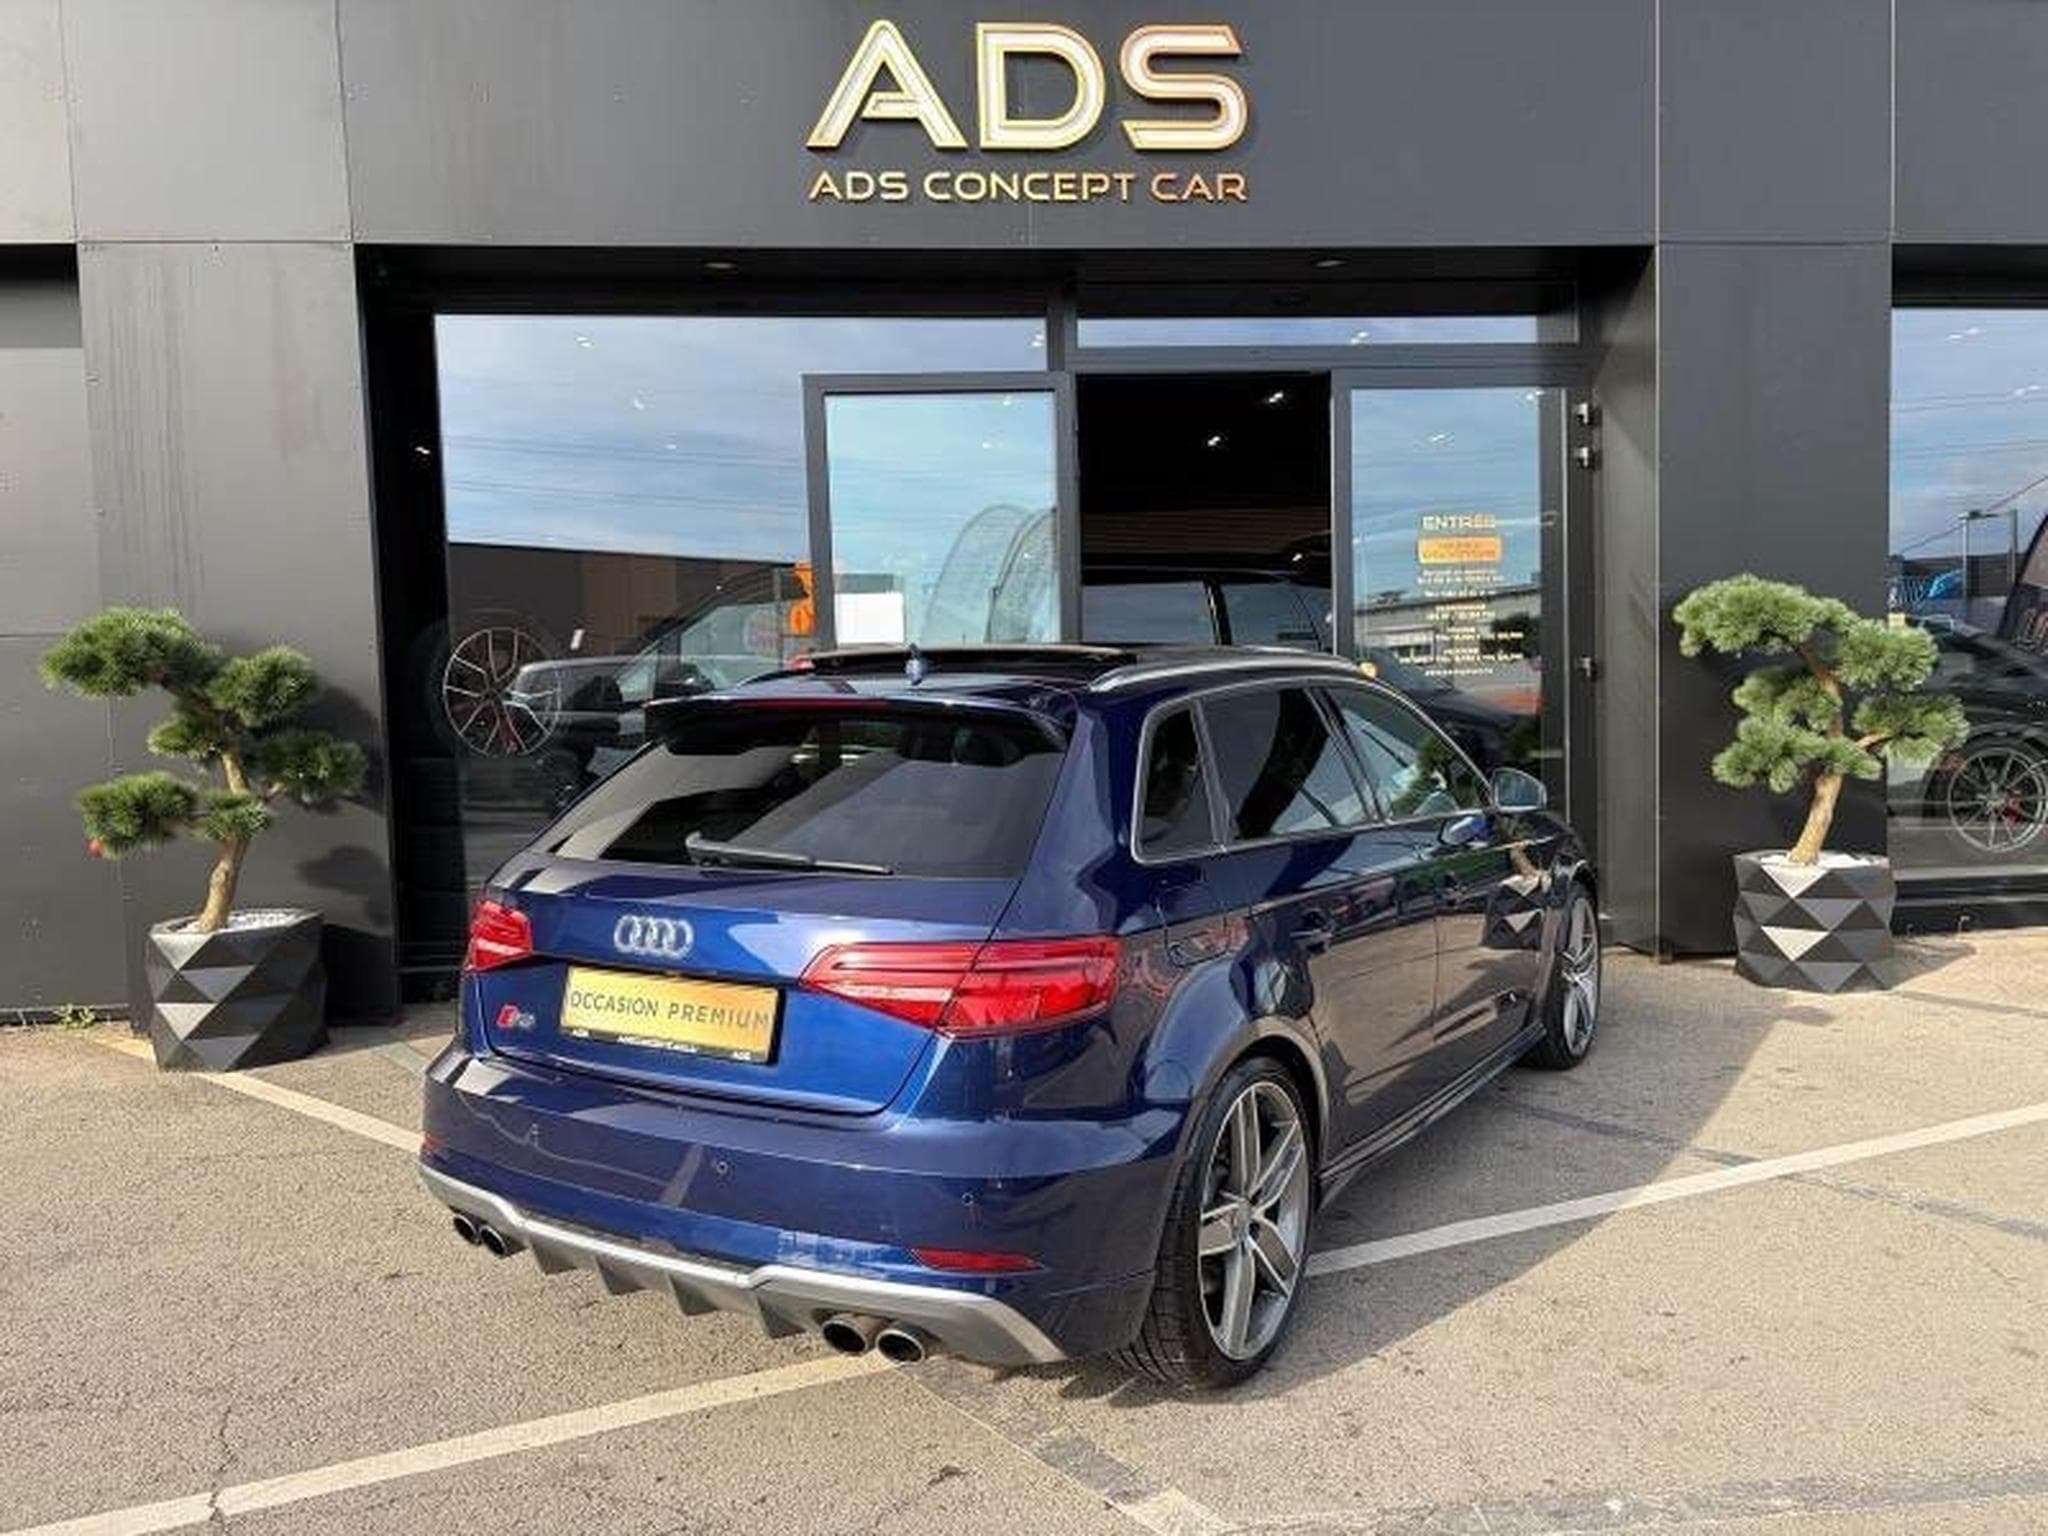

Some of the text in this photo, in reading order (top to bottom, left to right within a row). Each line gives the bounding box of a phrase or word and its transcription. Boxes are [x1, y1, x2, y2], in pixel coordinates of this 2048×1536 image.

[806, 19, 1249, 150] ADS
[809, 172, 1247, 202] ADS CONCEPT CAR
[570, 989, 770, 1028] OCCASION PREMIUM
